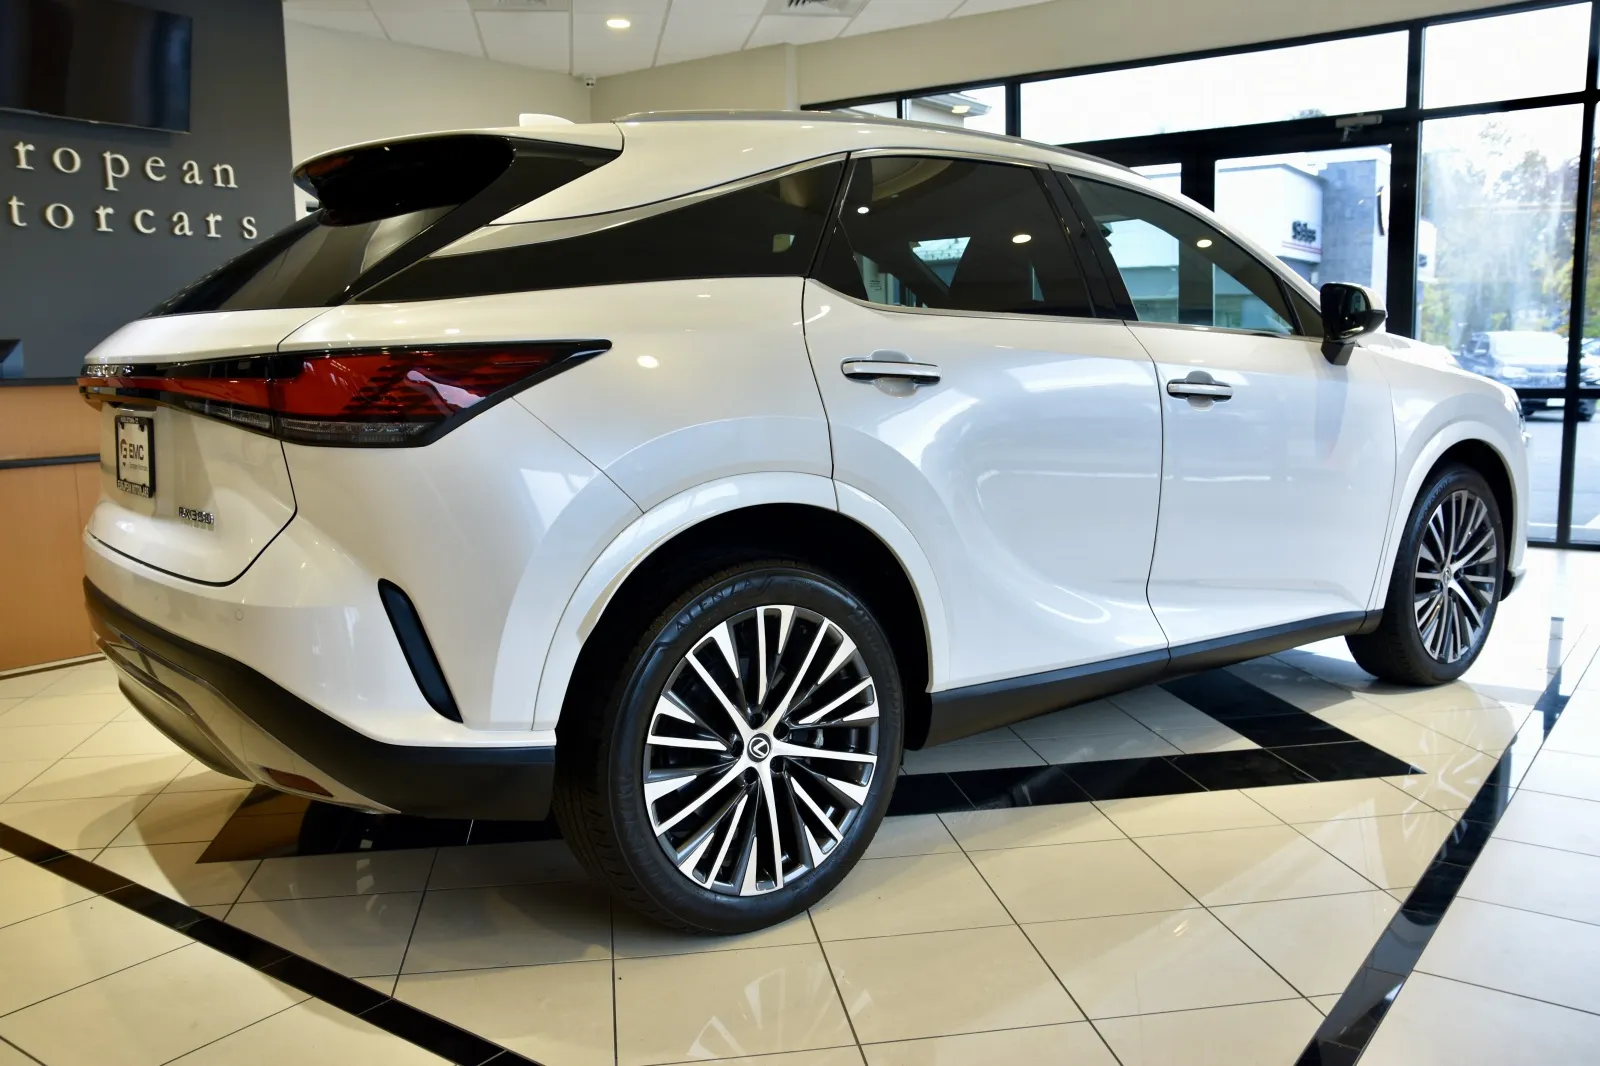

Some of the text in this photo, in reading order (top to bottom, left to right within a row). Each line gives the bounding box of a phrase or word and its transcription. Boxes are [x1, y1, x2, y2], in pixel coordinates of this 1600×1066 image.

[14, 141, 238, 191] ropean
[8, 195, 258, 240] torcars
[128, 444, 144, 461] EMC
[675, 578, 753, 632] ALENZA
